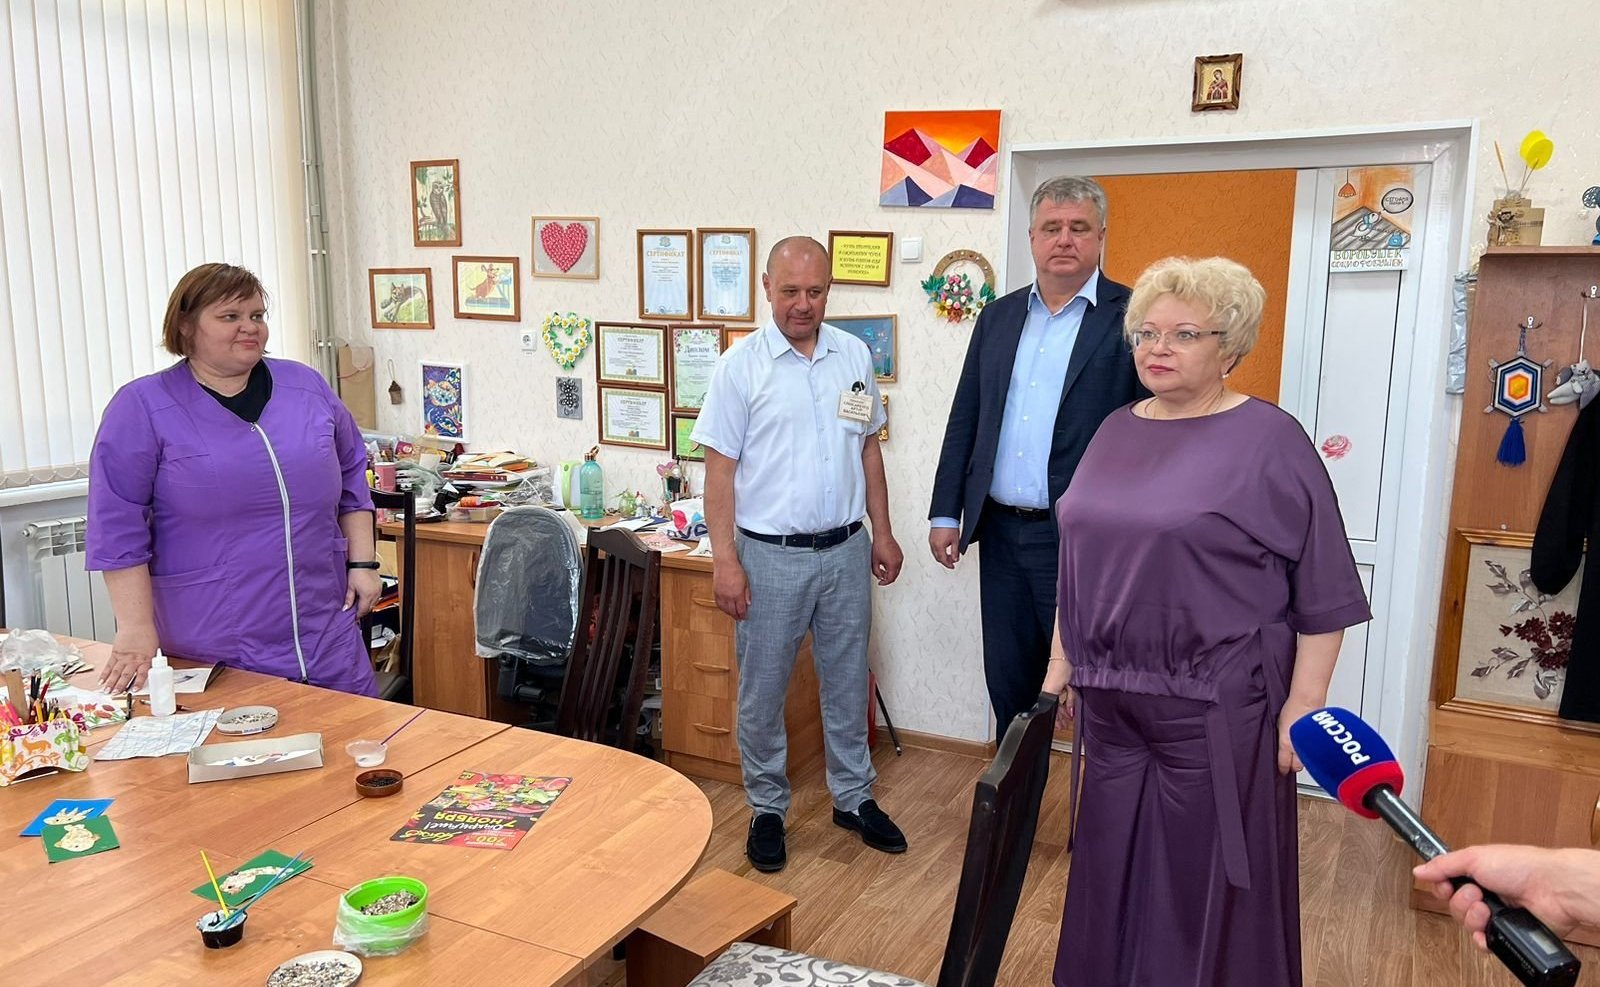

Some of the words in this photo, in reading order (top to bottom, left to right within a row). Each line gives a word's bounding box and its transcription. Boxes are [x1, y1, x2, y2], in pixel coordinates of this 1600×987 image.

[1311, 710, 1371, 766] РОССИЯ
[433, 811, 503, 825] НОЯБРЯ
[502, 819, 518, 828] 7
[424, 821, 504, 831] Открытие!
